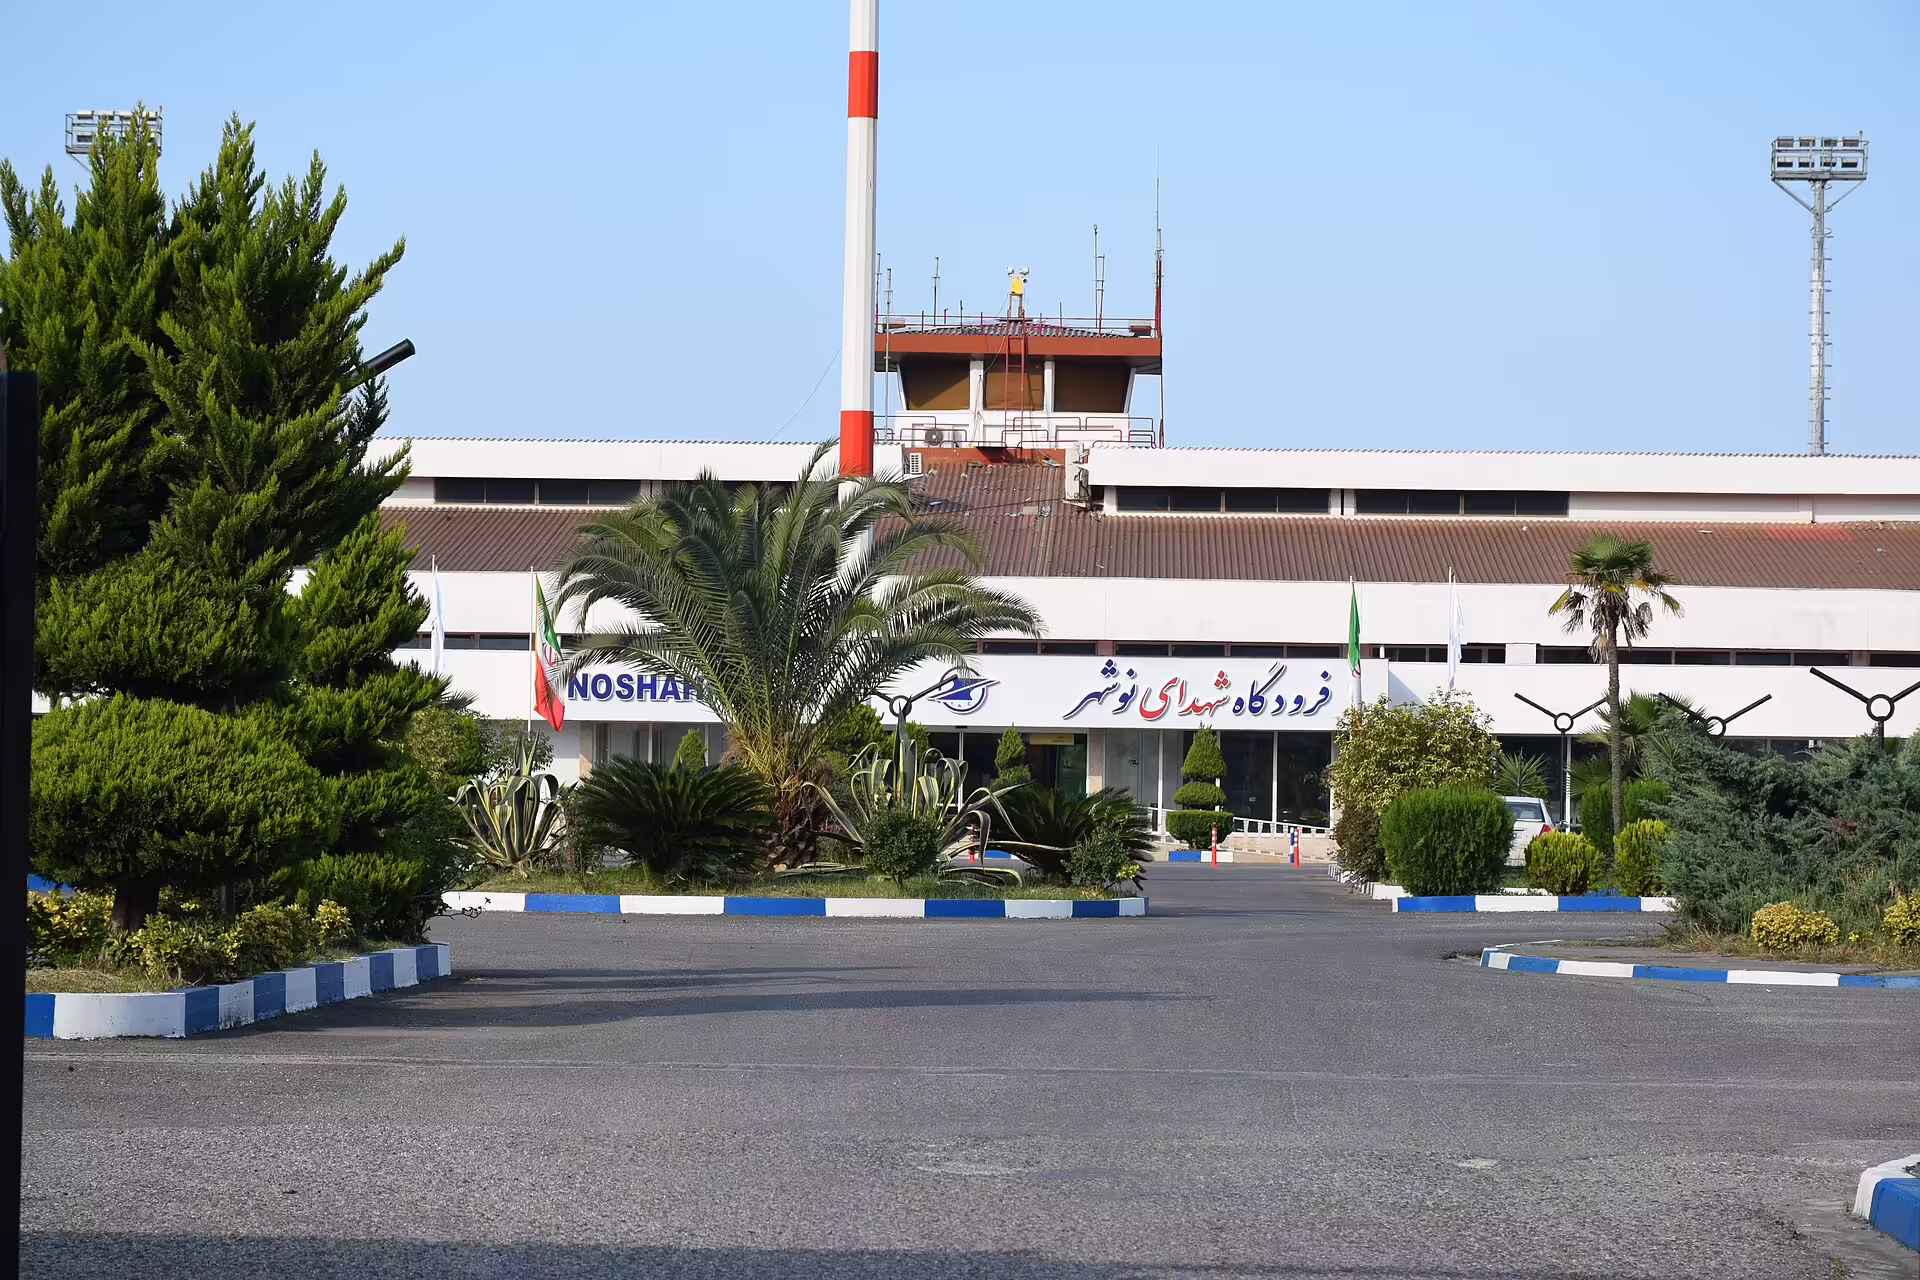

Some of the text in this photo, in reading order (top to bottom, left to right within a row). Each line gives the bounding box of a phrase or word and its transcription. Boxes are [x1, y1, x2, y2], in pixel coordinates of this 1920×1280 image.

[1063, 658, 1332, 721] فرودگاه شهدای نوشهر
